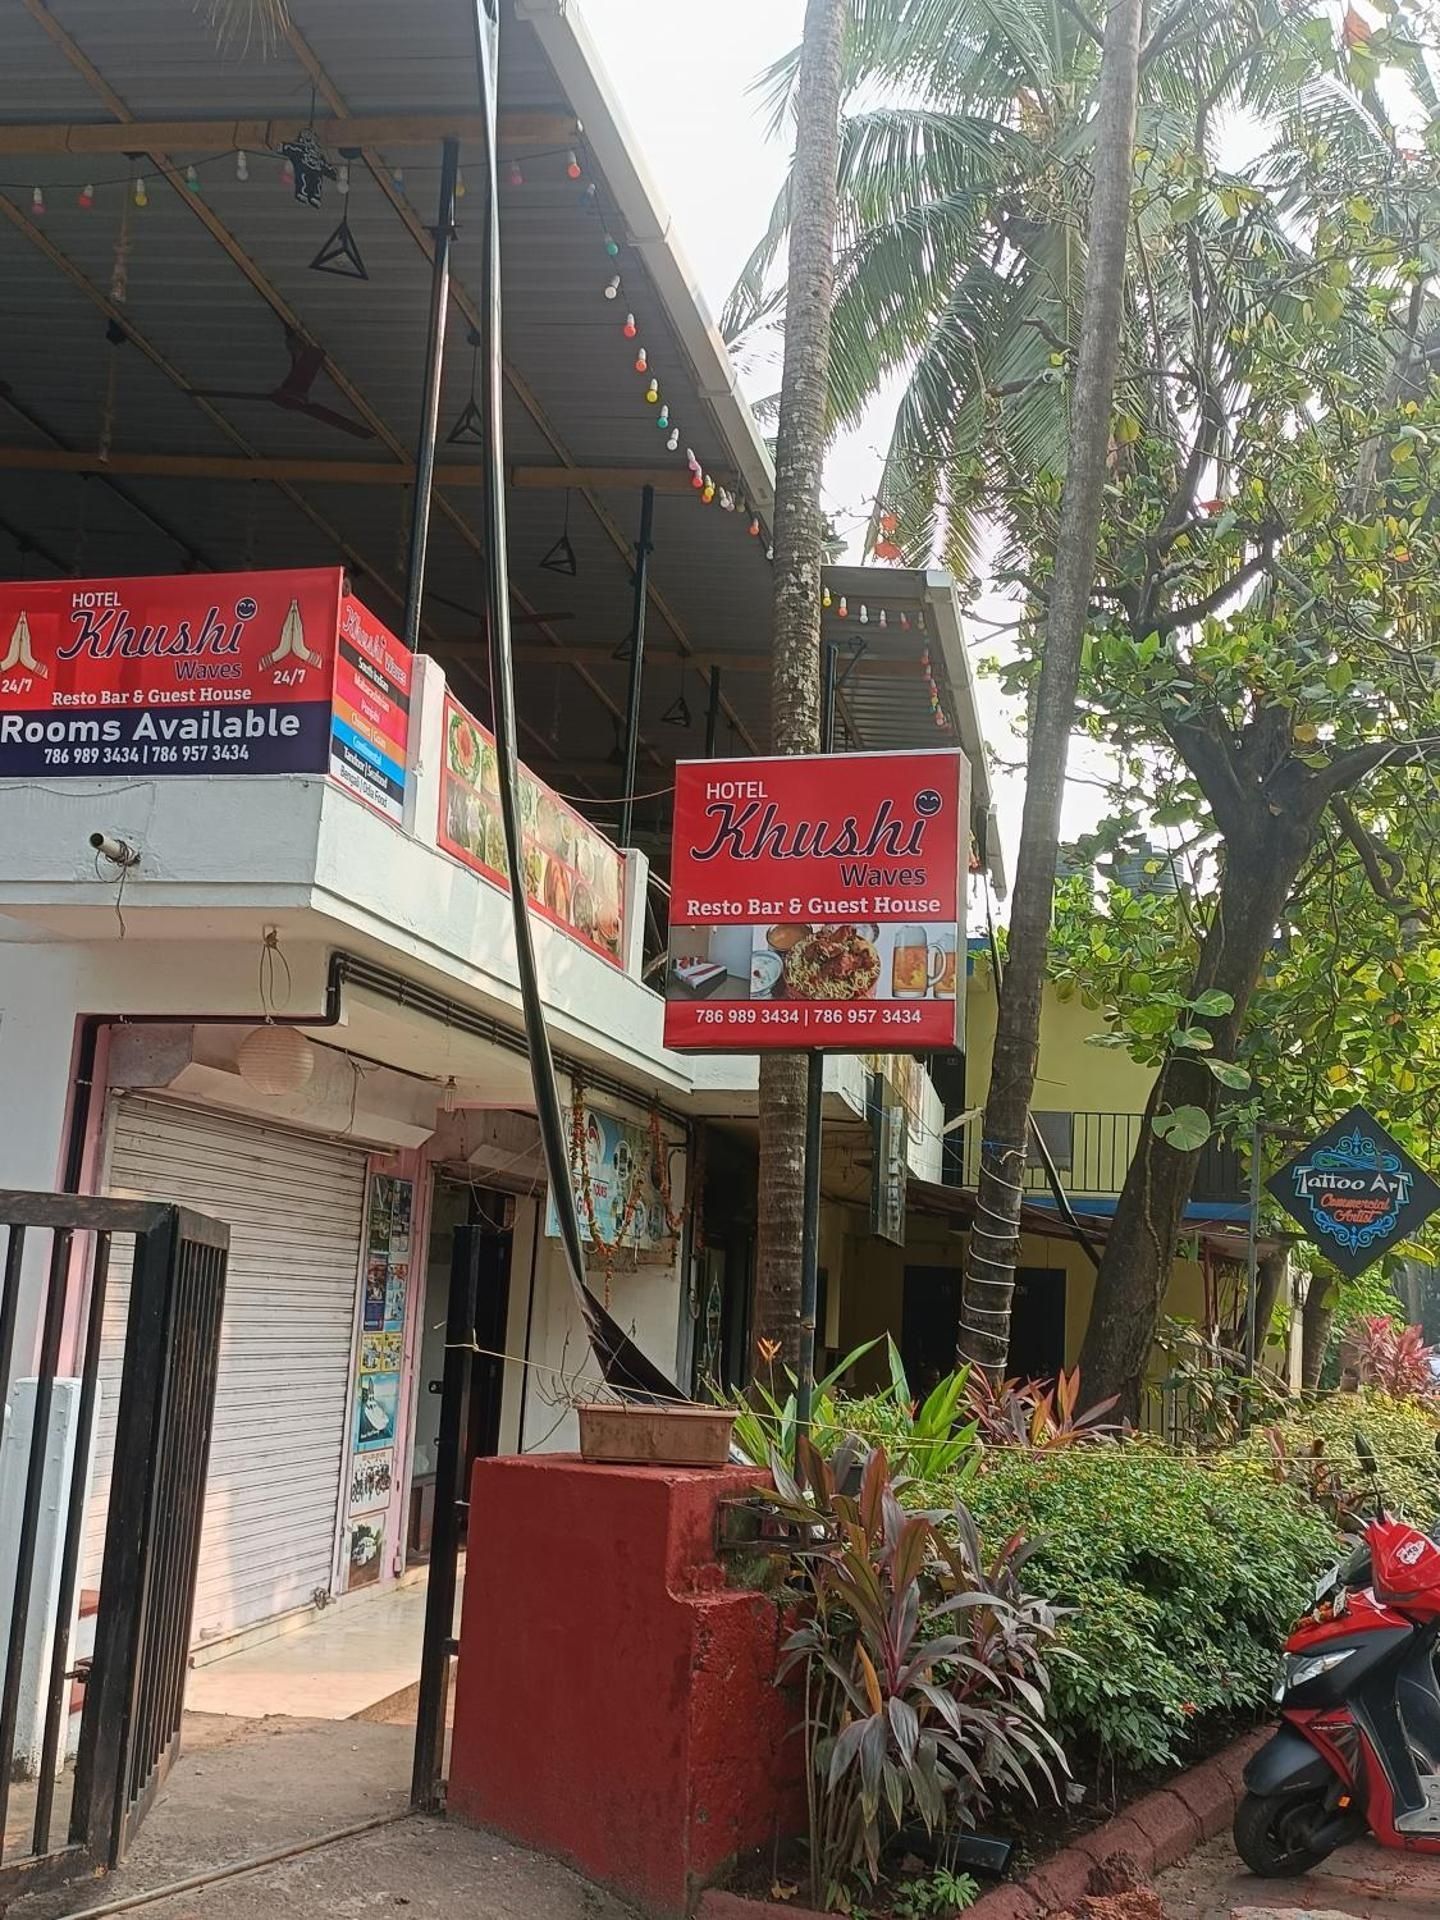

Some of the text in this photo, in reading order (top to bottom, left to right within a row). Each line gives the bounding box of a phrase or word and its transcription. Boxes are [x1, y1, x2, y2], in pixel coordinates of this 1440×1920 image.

[72, 592, 121, 608] HOTEL
[57, 597, 257, 660] Khushi
[176, 660, 242, 680] Waves
[273, 670, 306, 686] 24/7
[1, 679, 32, 694] 24/7
[52, 687, 252, 706] Resto Bar & Guest House
[1, 708, 301, 744] Rooms Available
[44, 748, 71, 764] 786
[73, 747, 99, 764] 989
[103, 747, 139, 763] 3434
[152, 746, 178, 762] 786
[182, 745, 208, 761] 957
[212, 744, 249, 761] 3434
[706, 781, 768, 800] HOTEL
[690, 789, 943, 861] Khushi
[840, 863, 926, 888] Waves
[686, 896, 941, 916] Resto Bar & Guest House
[696, 1009, 723, 1024] 786
[728, 1009, 756, 1024] 989
[761, 1009, 799, 1024] 3434
[814, 1009, 842, 1024] 786
[847, 1009, 877, 1024] 957
[882, 1009, 922, 1024] 3434
[1298, 1168, 1366, 1194] Tattoo
